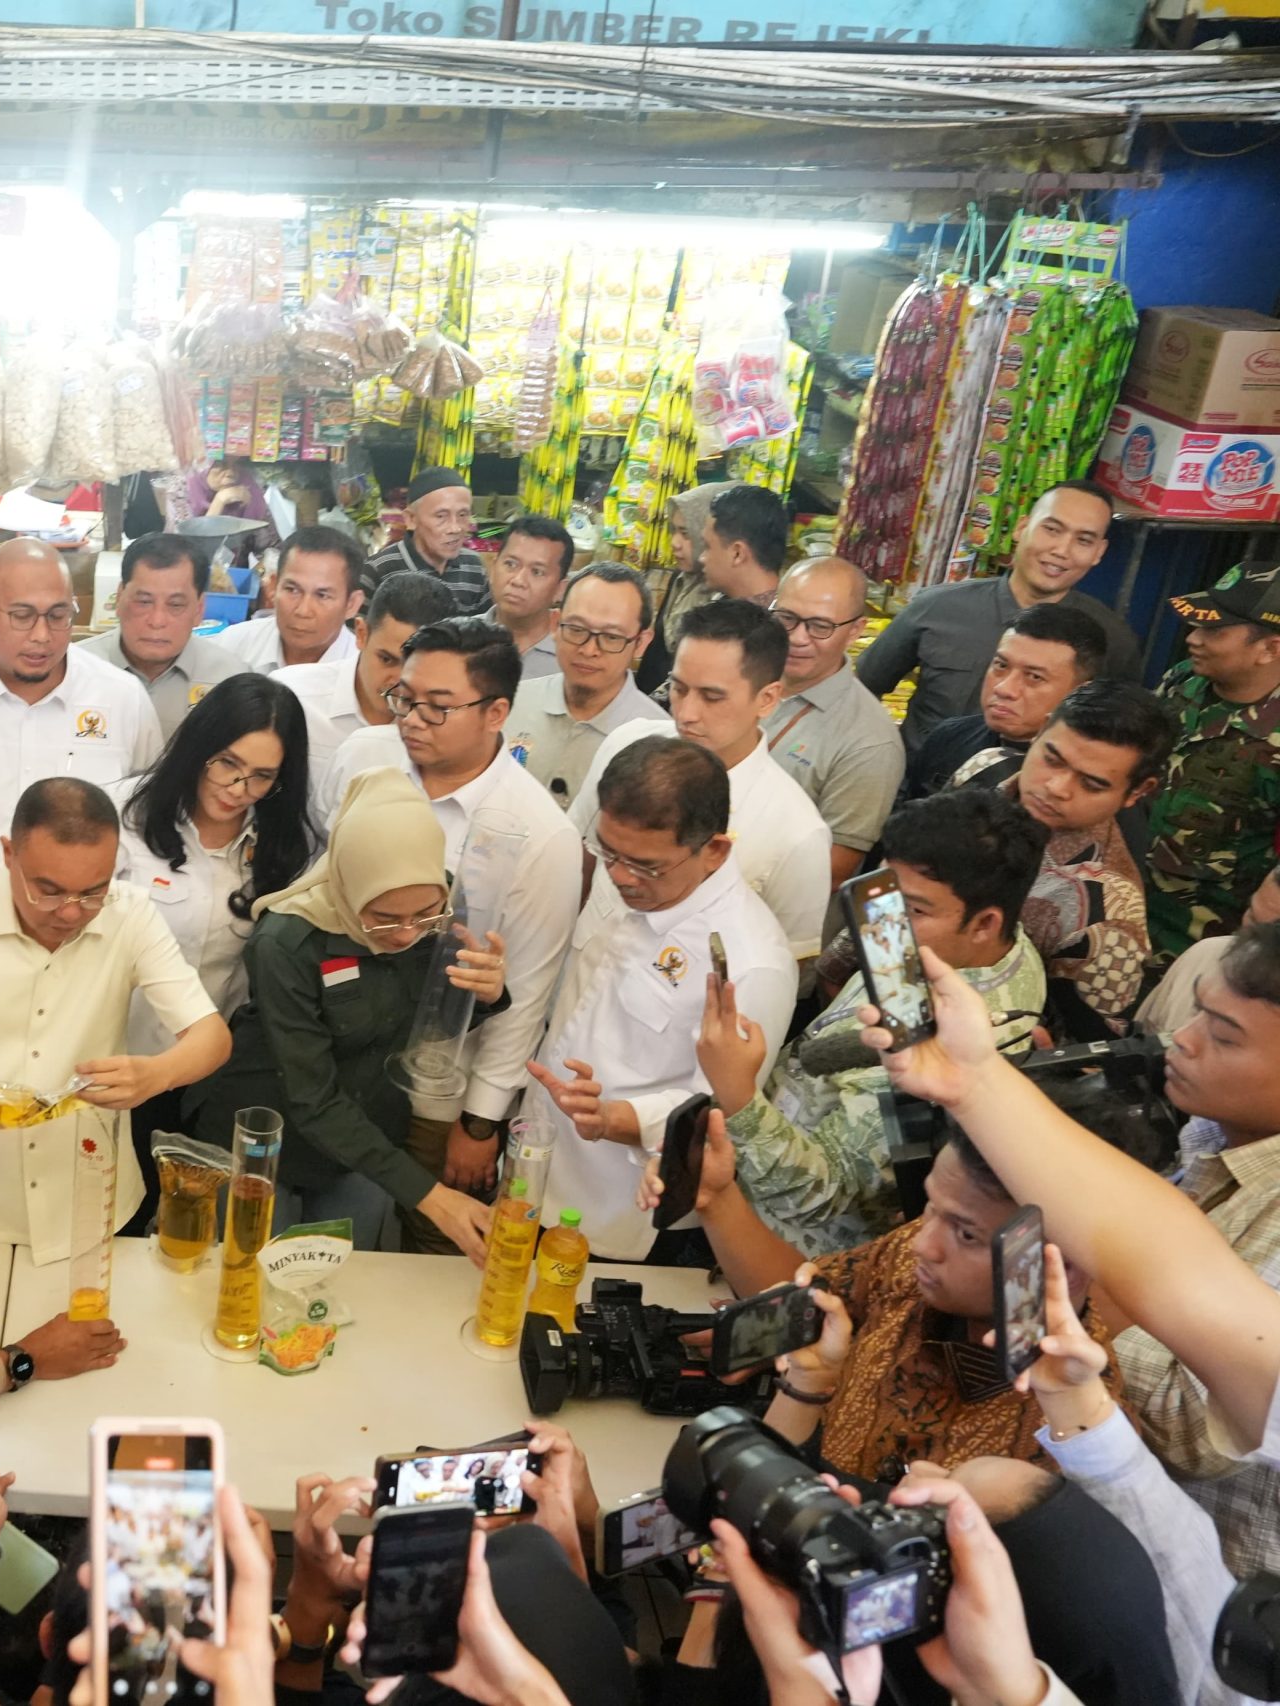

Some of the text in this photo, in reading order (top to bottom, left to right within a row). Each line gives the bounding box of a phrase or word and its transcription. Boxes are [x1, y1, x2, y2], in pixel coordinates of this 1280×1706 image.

[315, 0, 444, 36] Toko
[463, 6, 703, 45] SUMBER
[1221, 449, 1261, 469] POP
[1221, 464, 1262, 484] MIE
